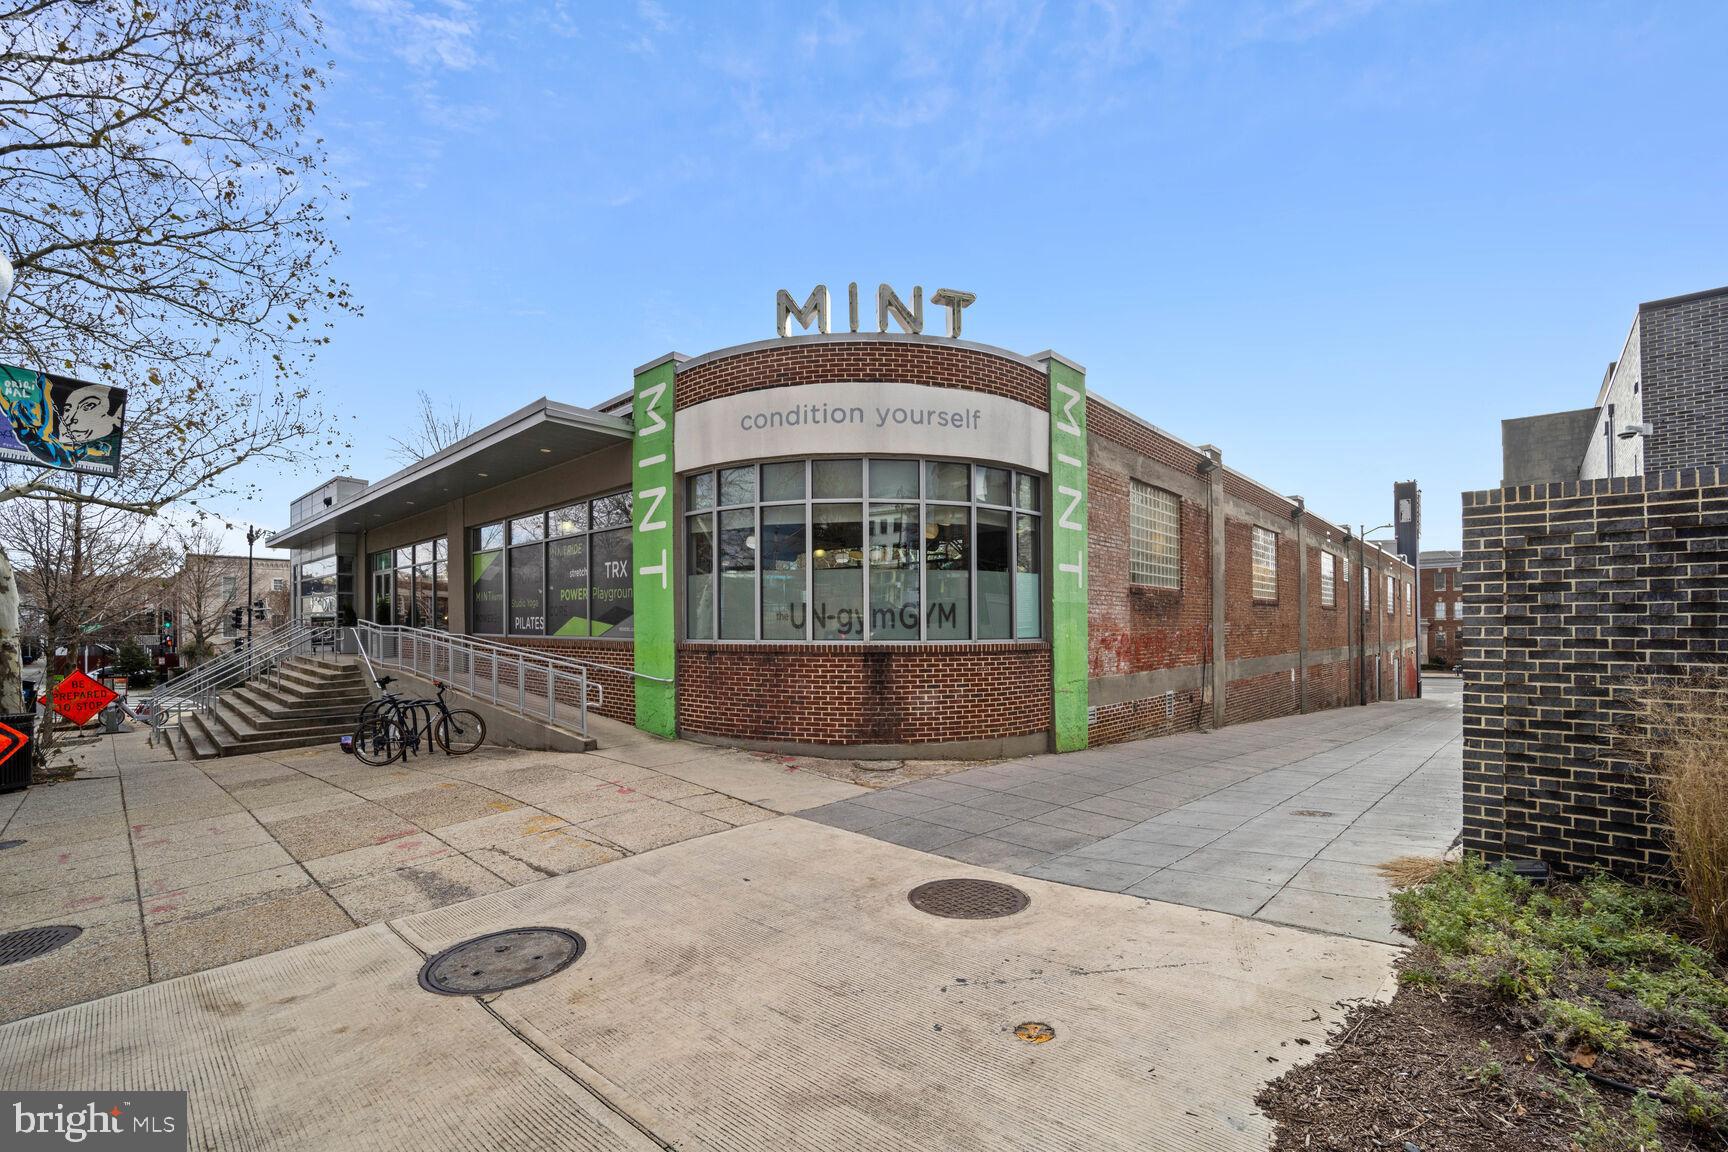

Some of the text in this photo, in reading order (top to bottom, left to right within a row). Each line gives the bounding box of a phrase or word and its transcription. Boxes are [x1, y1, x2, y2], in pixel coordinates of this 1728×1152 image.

[776, 282, 977, 338] MINT
[740, 403, 981, 431] condition yourself
[638, 382, 668, 590] MINT
[1056, 382, 1084, 589] MINT
[569, 566, 589, 578] stretch
[604, 560, 628, 579] TRX
[560, 586, 633, 602] POWER Playgroun
[514, 616, 545, 630] PILATES
[776, 612, 789, 622] the
[72, 680, 85, 689] BE
[53, 689, 107, 701] PREPARED
[77, 701, 103, 711] STOP
